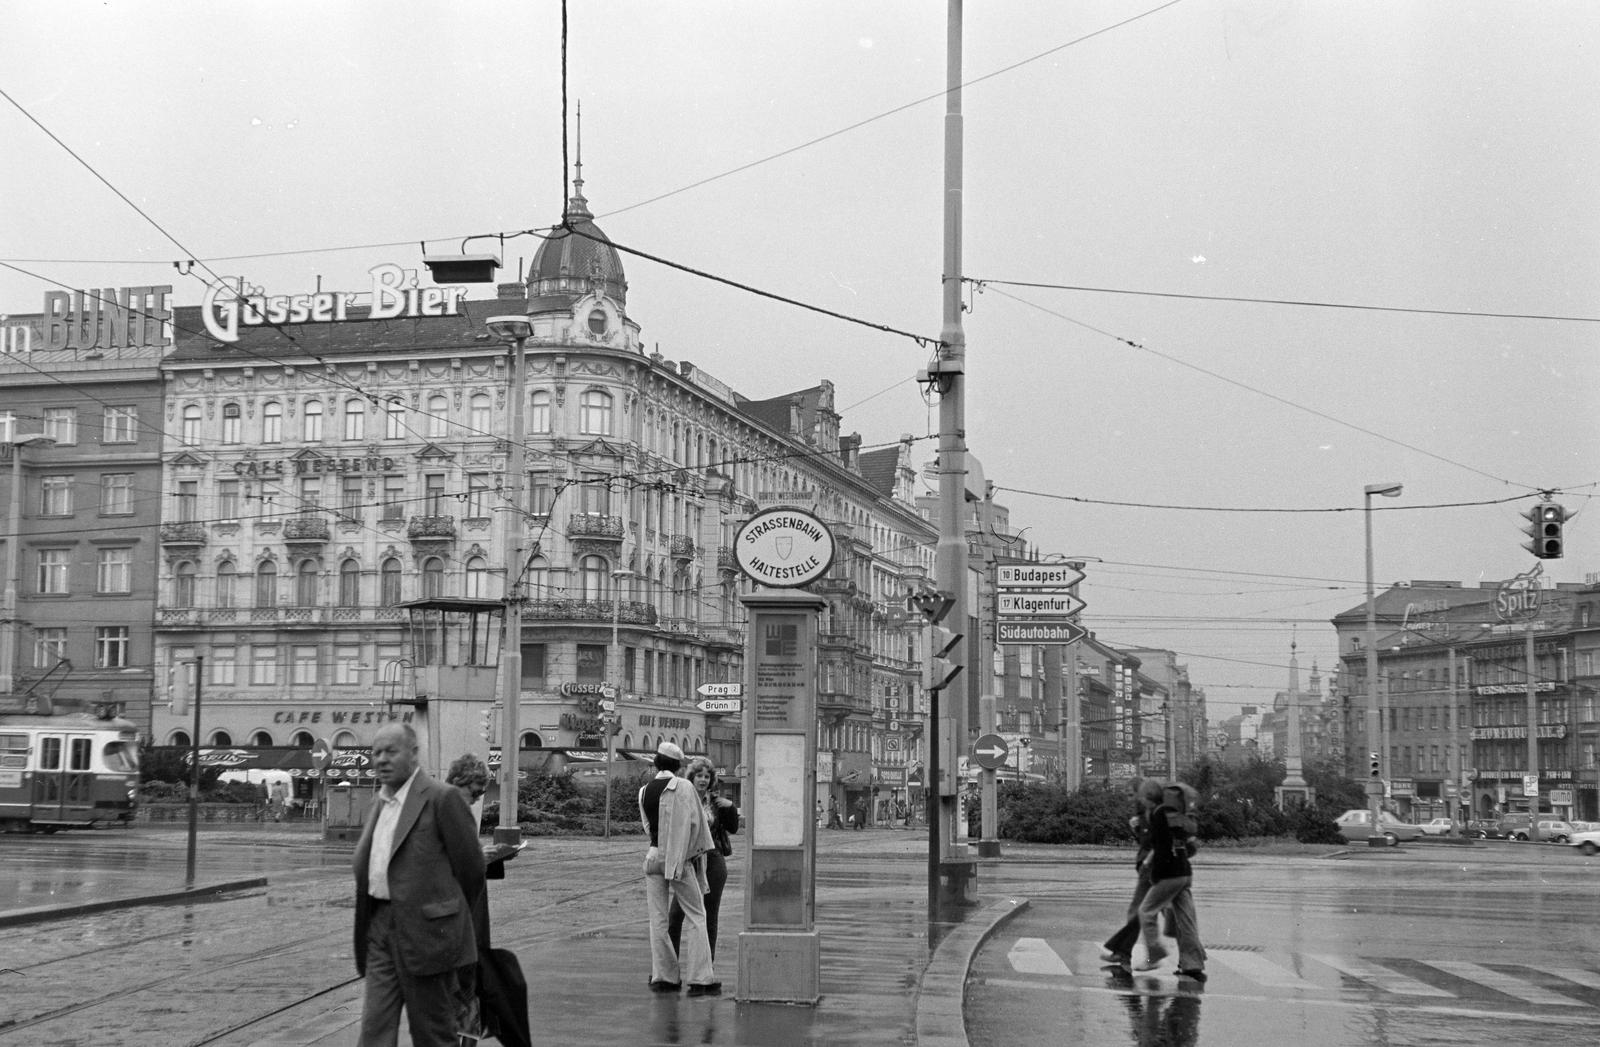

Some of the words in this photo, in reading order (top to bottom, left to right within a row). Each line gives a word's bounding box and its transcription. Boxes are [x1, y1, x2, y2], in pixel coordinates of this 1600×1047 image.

[202, 275, 356, 343] Gösser
[368, 263, 468, 318] Bier
[43, 285, 172, 352] BUNTE
[745, 517, 824, 544] STRASSENBAHN
[749, 555, 820, 579] HALTESTELLE
[1002, 570, 1011, 579] 10
[1014, 569, 1067, 583] Budapest
[1003, 599, 1011, 608] 17
[1014, 597, 1071, 613] Klagenfurt
[1498, 590, 1538, 616] Spitz
[1000, 626, 1070, 639] Südautobahn
[708, 685, 728, 695] Prag
[705, 701, 729, 709] Brünn
[890, 687, 898, 731] FOTO
[273, 711, 322, 724] CAFE
[332, 711, 415, 724] WESTEN
